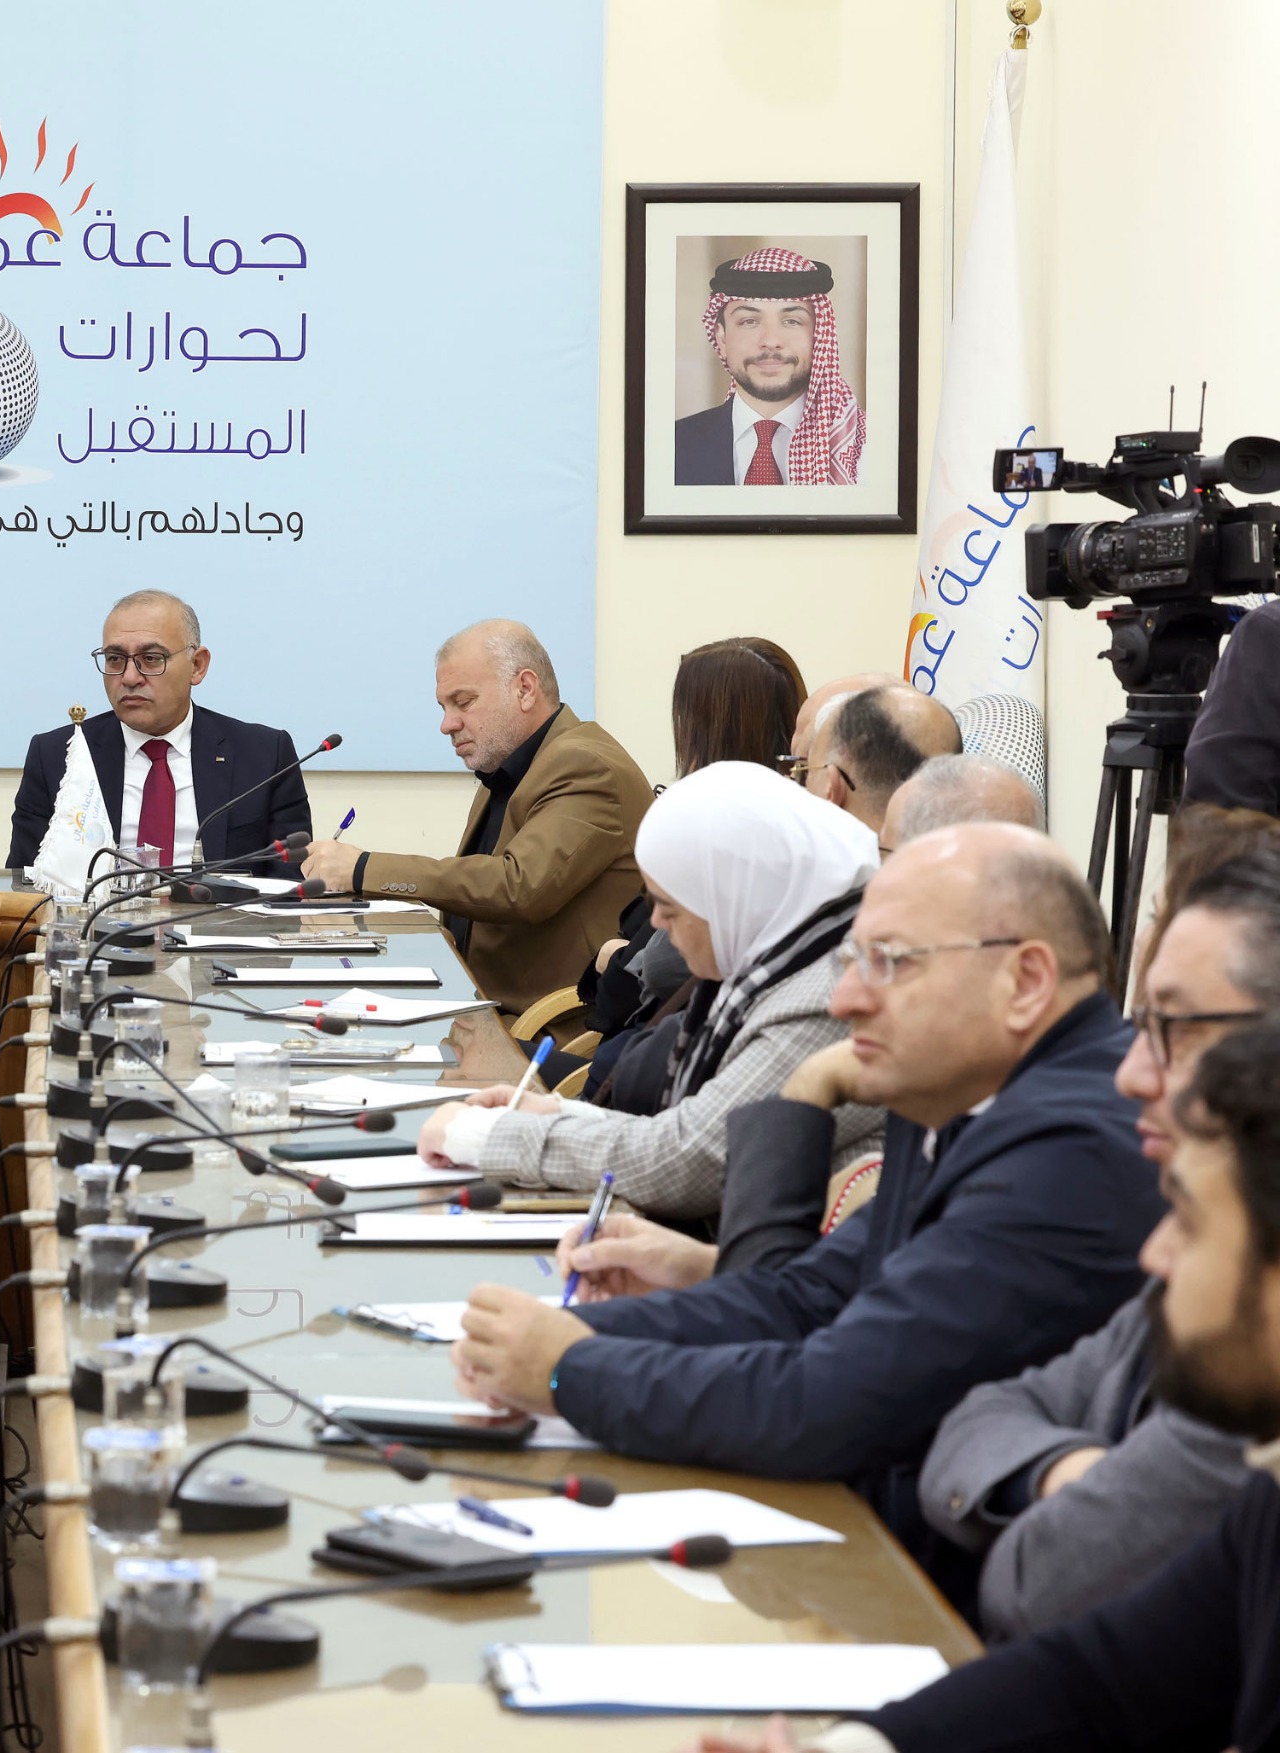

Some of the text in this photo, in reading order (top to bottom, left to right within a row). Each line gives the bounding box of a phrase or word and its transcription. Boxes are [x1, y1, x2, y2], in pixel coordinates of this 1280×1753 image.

[82, 209, 308, 282] جماعة
[58, 311, 308, 373] لحوارات
[57, 404, 307, 465] المستقبل
[47, 500, 131, 548] بالتي
[137, 501, 305, 542] وجادلهم
